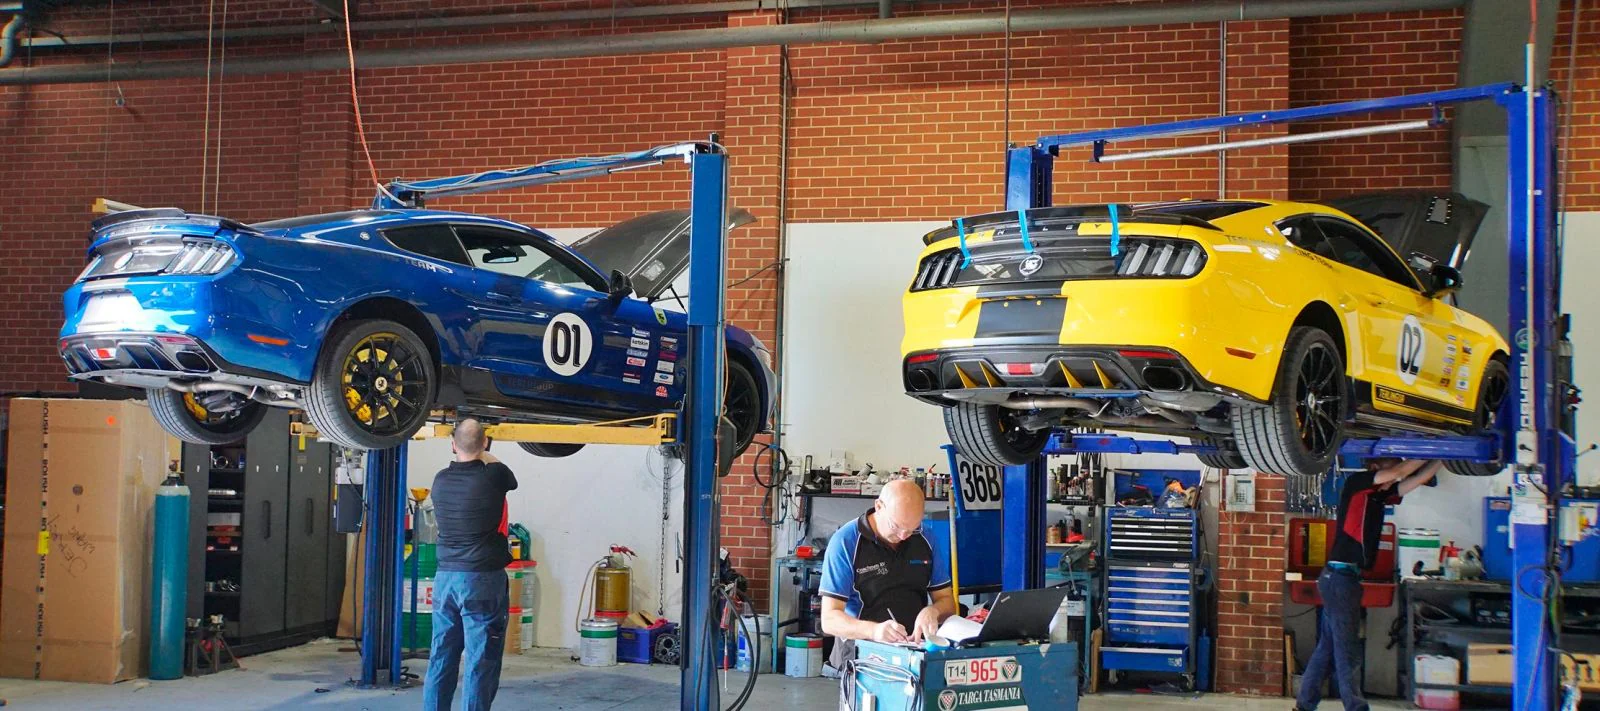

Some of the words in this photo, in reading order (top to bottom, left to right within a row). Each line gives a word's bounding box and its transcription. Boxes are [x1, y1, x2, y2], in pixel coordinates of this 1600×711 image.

[405, 257, 436, 273] TEAM
[550, 321, 581, 368] 01
[1400, 323, 1421, 376] 02
[960, 461, 1001, 502] 36B
[948, 665, 966, 678] T14
[970, 659, 998, 683] 965
[959, 690, 983, 705] TARGA
[983, 687, 1021, 703] TASMANIA
